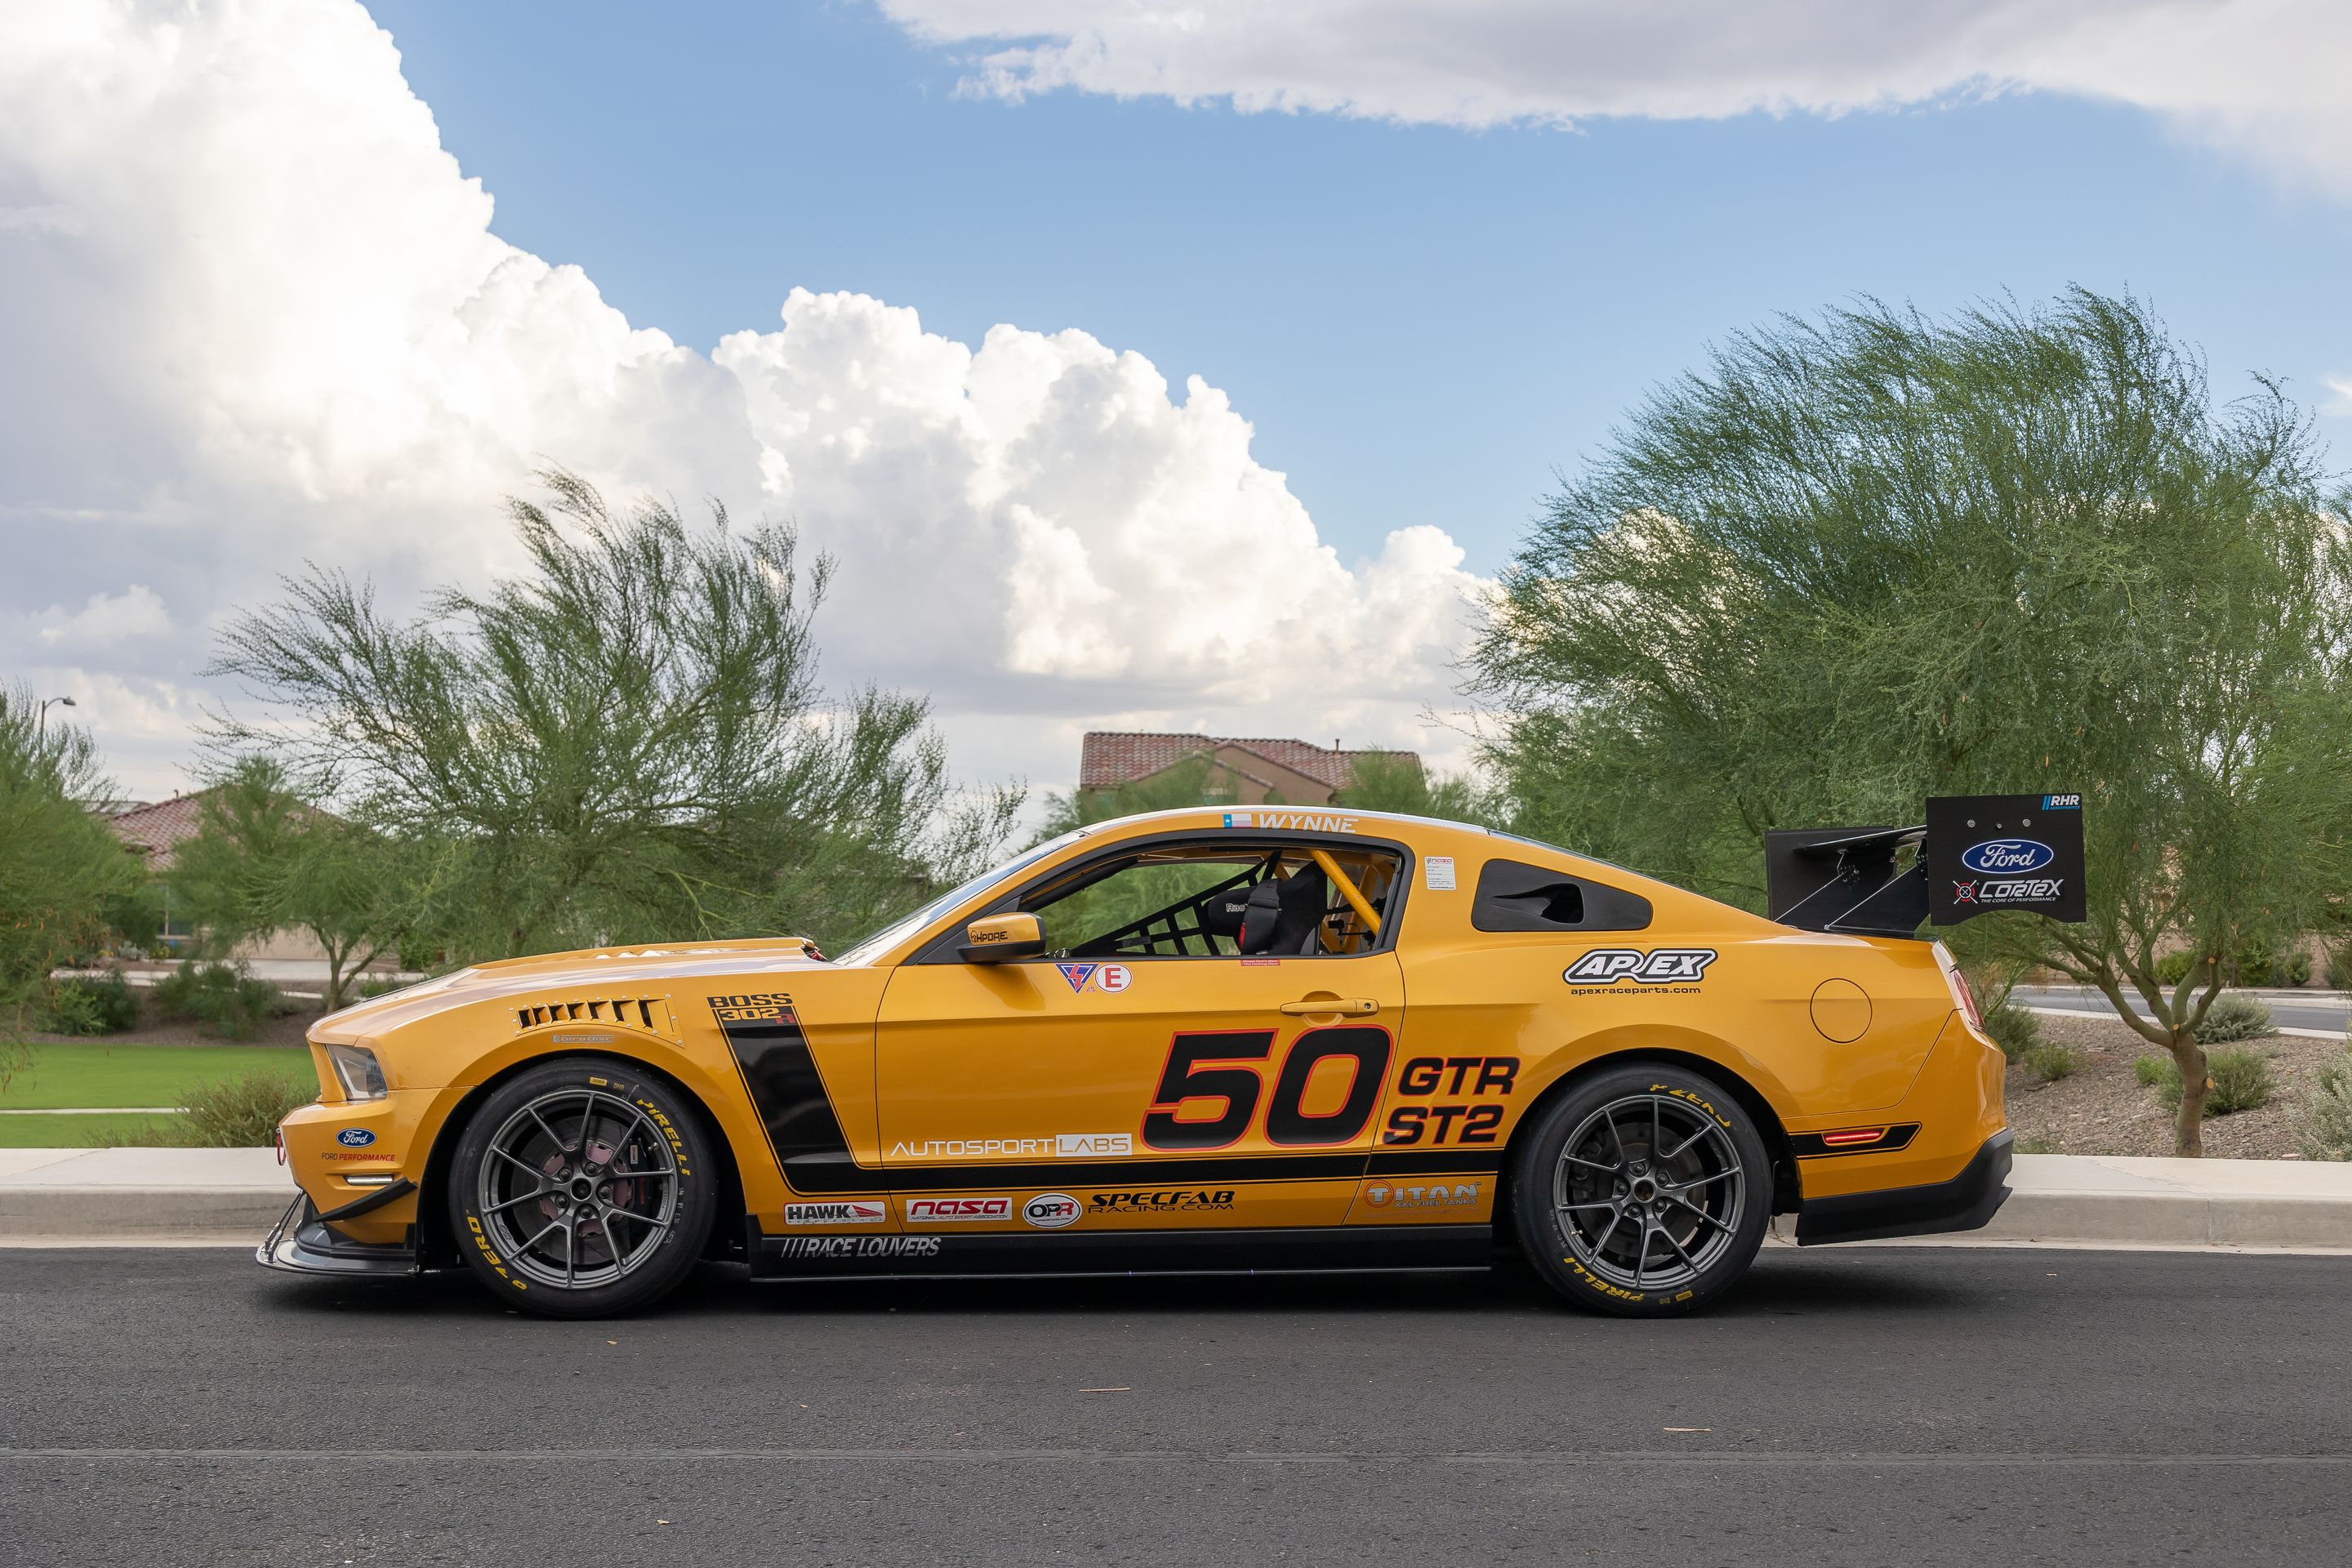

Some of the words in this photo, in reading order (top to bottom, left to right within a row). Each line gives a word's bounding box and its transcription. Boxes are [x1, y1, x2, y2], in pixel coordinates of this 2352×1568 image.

[2051, 795, 2080, 806] RHR
[1258, 813, 1359, 834] WYNNE
[1980, 844, 2036, 868] Ford
[1979, 879, 2065, 898] CORTEX
[1105, 967, 1122, 988] E
[707, 993, 793, 1008] BOSS
[1570, 987, 1701, 996] apexraceparts.com
[719, 1007, 782, 1021] 302
[1397, 1056, 1521, 1097] GTR
[1139, 1023, 1395, 1152] 50
[1382, 1103, 1506, 1147] ST2
[343, 1130, 369, 1143] Ford
[890, 1138, 1054, 1156] AUTOSPORT
[1058, 1137, 1128, 1153] LABS
[322, 1152, 338, 1160] FORD
[339, 1153, 396, 1161] PERFORMANCE
[1089, 1191, 1235, 1207] SPECFAB
[1368, 1183, 1478, 1202] TITAN
[787, 1205, 851, 1220] HAWK
[1028, 1202, 1075, 1218] OPR
[1088, 1204, 1235, 1214] RACING.COM
[804, 1238, 857, 1258] RACE
[857, 1237, 942, 1257] LOUVERS
[1563, 1257, 1645, 1301] PIRELLI
